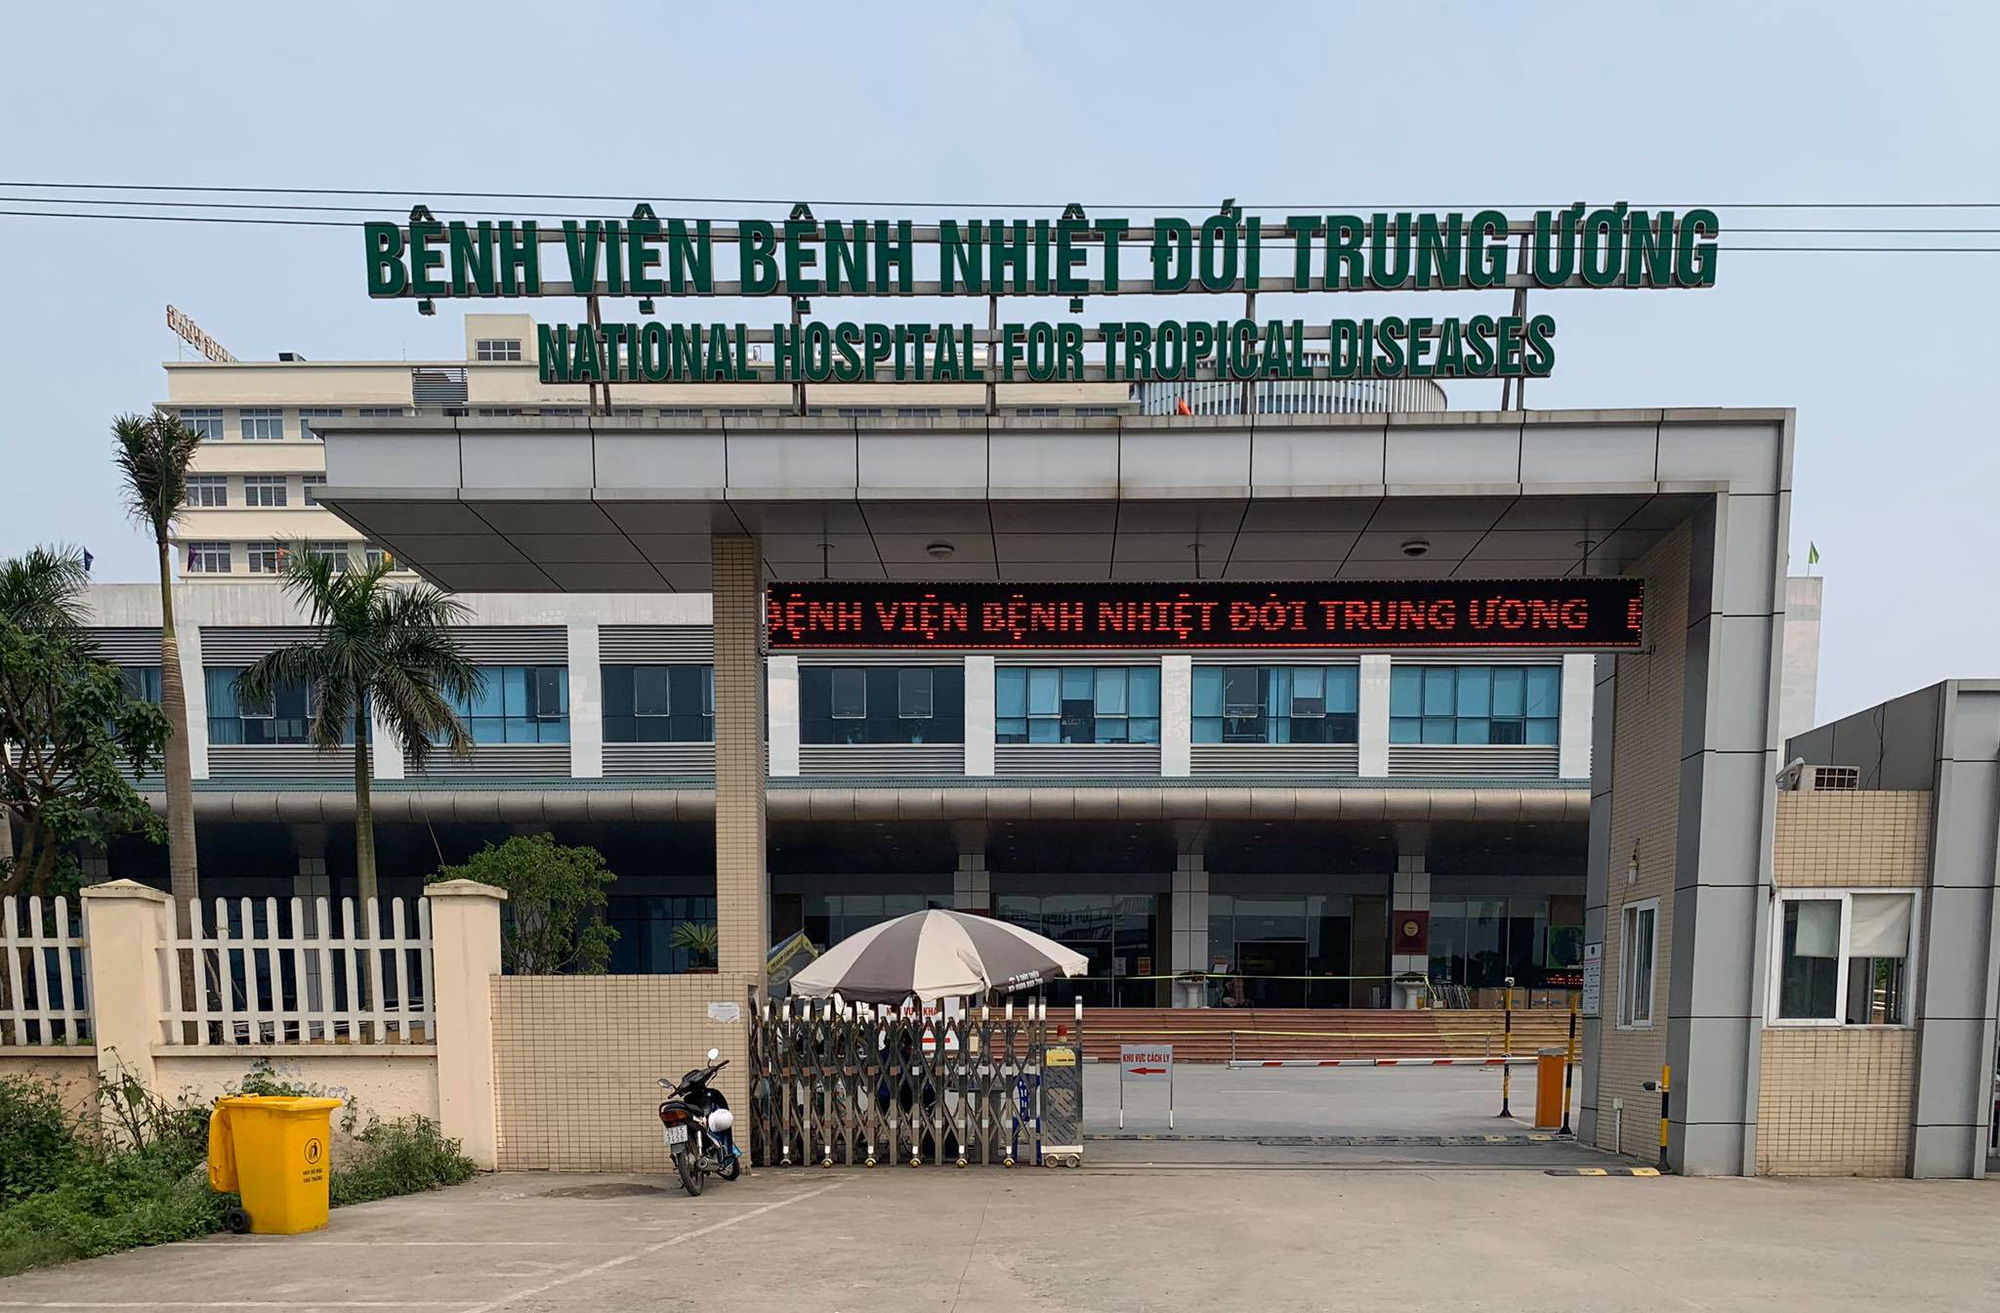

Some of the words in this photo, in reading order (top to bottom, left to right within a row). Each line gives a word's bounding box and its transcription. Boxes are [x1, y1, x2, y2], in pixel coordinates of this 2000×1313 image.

[364, 204, 540, 316] BỆNH
[561, 203, 713, 315] VIỆN
[738, 202, 913, 315] BỆNH
[940, 202, 1130, 314] NHIỆT
[1149, 197, 1263, 294] ĐỚI
[1286, 208, 1510, 292] TRUNG
[1533, 201, 1720, 290] ƯƠNG
[537, 321, 759, 384] NATIONAL
[773, 320, 986, 384] HOSPITAL
[1003, 321, 1085, 383] FOR
[1099, 318, 1315, 382] TROPICAL
[1330, 314, 1557, 379] DISEASES
[875, 593, 968, 640] VIỆN
[982, 593, 1084, 640] BỆNH
[1098, 593, 1220, 640] NHIỆT
[1319, 600, 1457, 631] TRUNG
[1468, 595, 1589, 629] ƯƠNG
